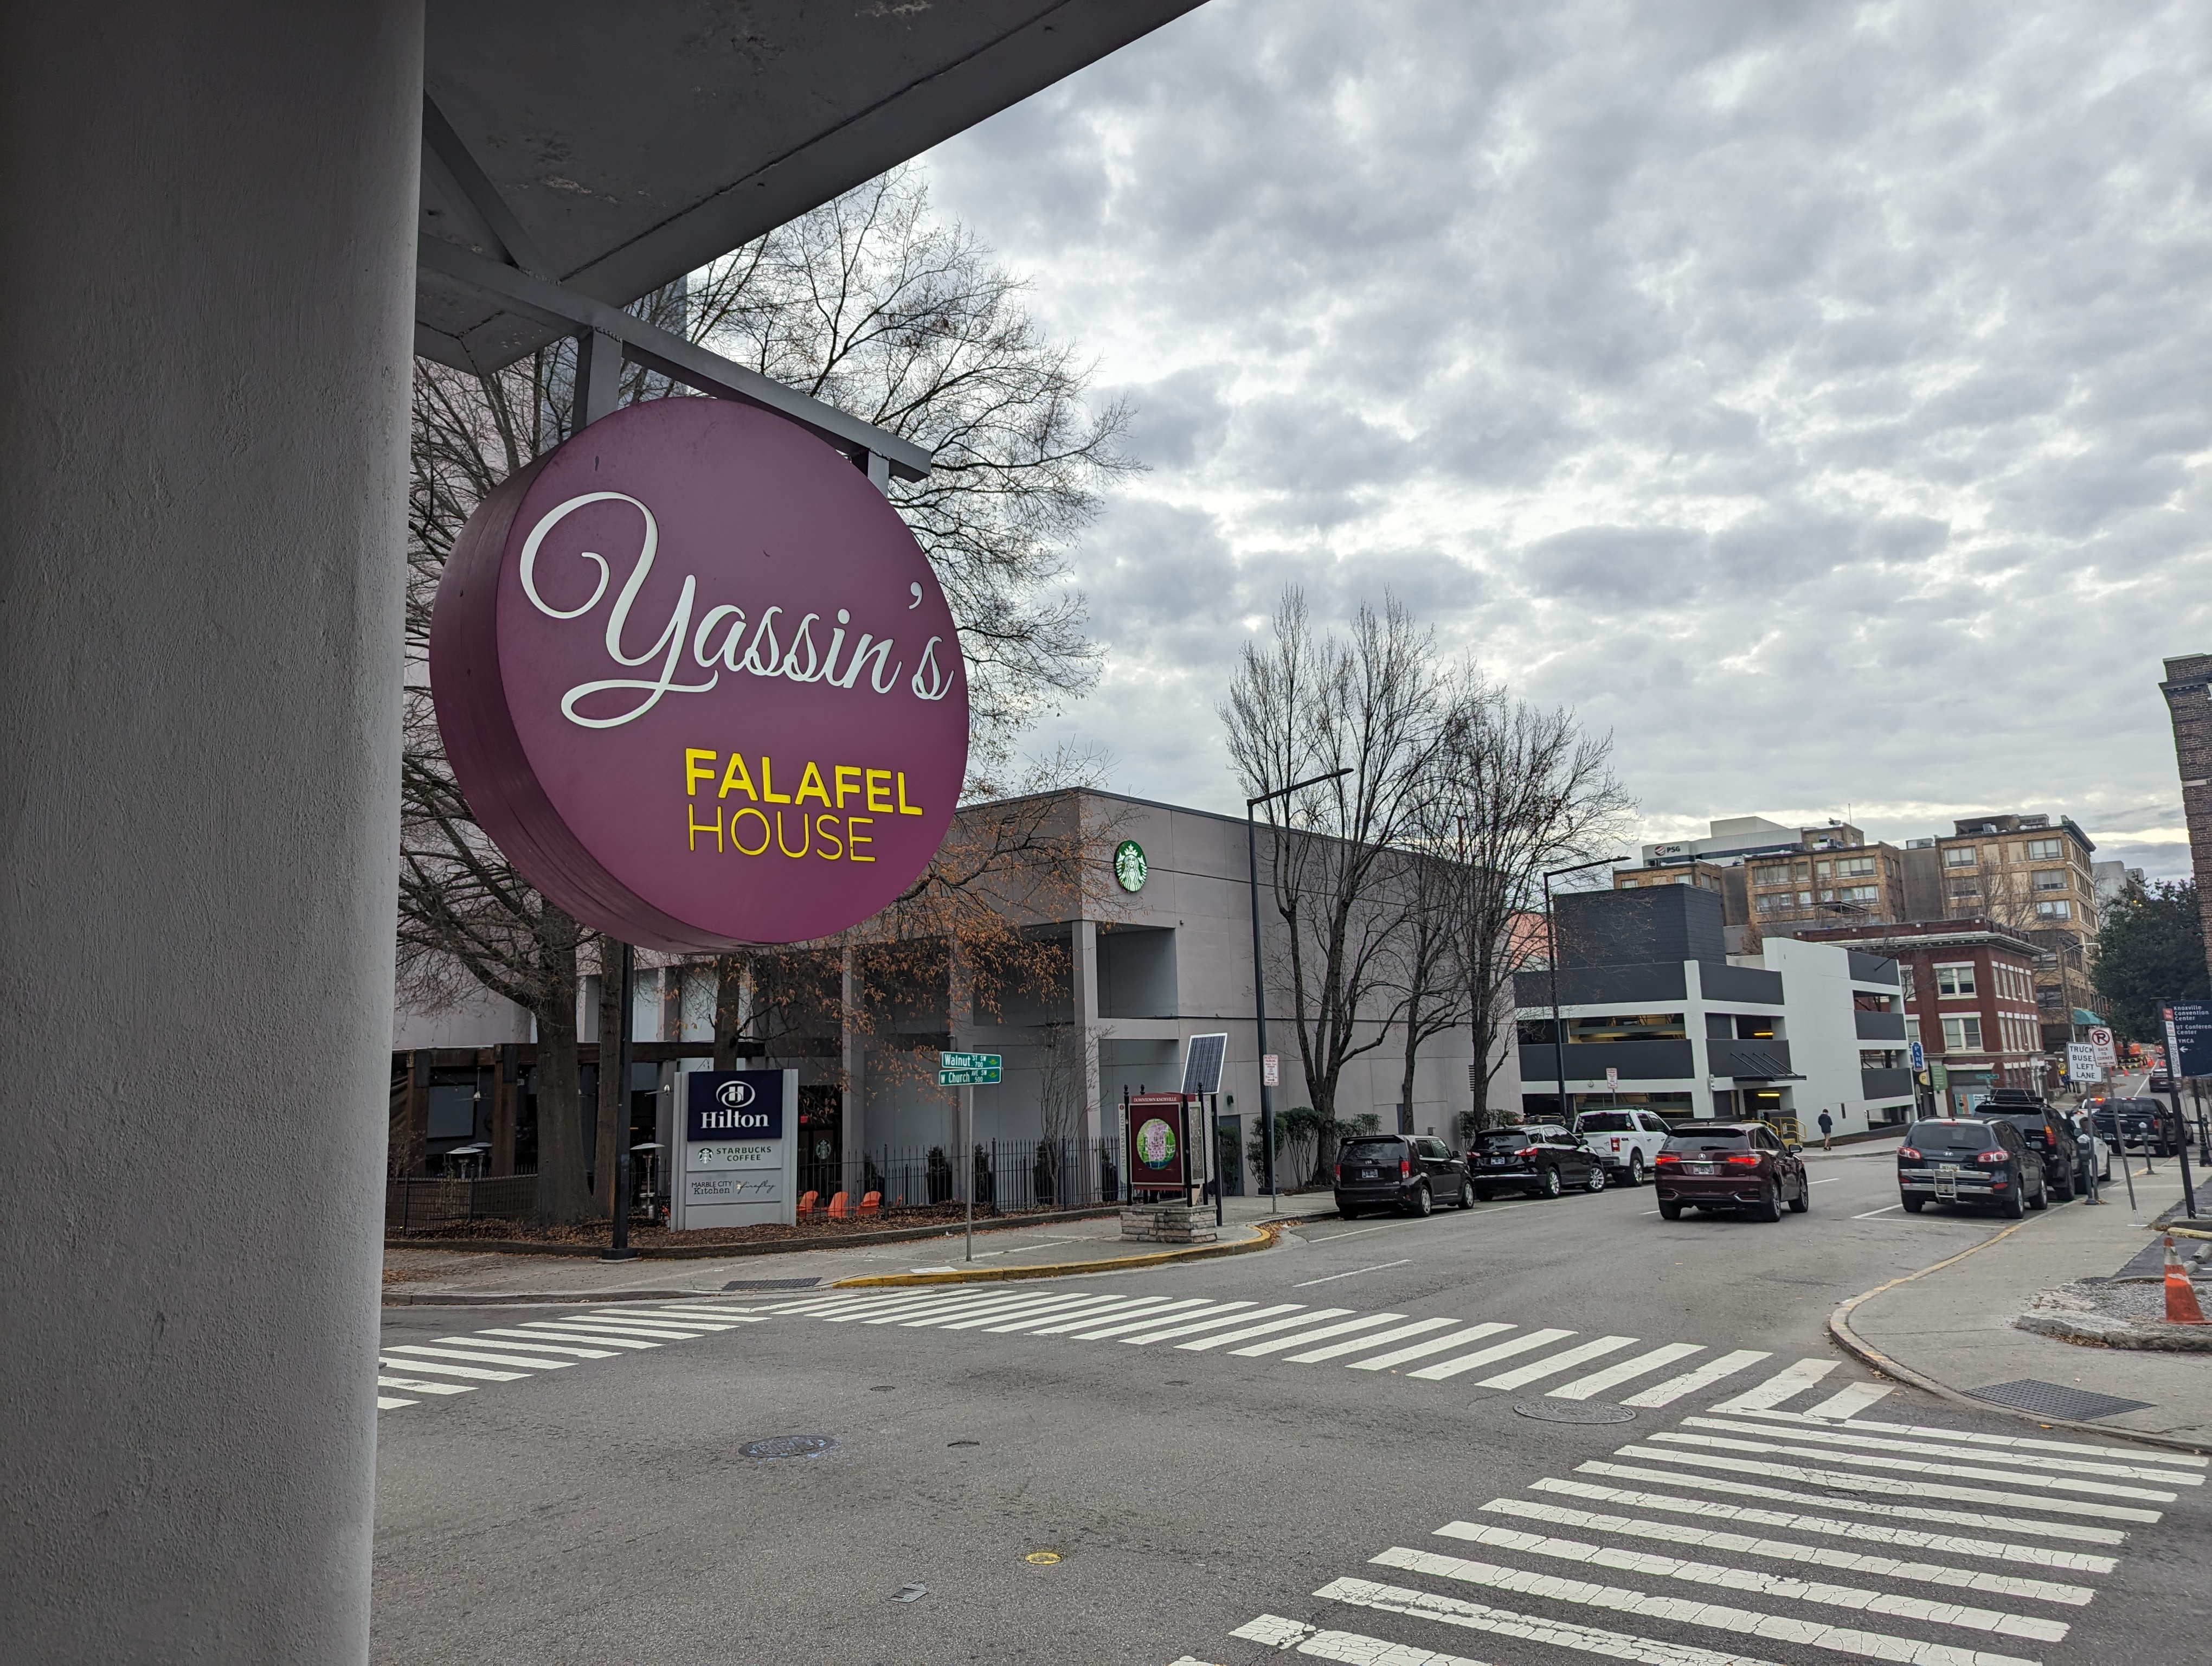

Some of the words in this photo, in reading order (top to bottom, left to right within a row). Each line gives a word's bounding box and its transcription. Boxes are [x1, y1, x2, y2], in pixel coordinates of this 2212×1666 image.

[519, 491, 954, 728] Yassin's
[685, 747, 923, 816] FALAFEL
[688, 803, 876, 863] HOUSE
[2069, 1046, 2093, 1054] TRUCK
[944, 1054, 971, 1067] Walnut
[941, 1074, 946, 1084] W
[949, 1072, 970, 1084] Church
[2076, 1071, 2096, 1079] LANE
[700, 1109, 769, 1129] Hilton
[716, 1146, 771, 1155] STARBUCKS
[738, 1180, 775, 1194] firefly
